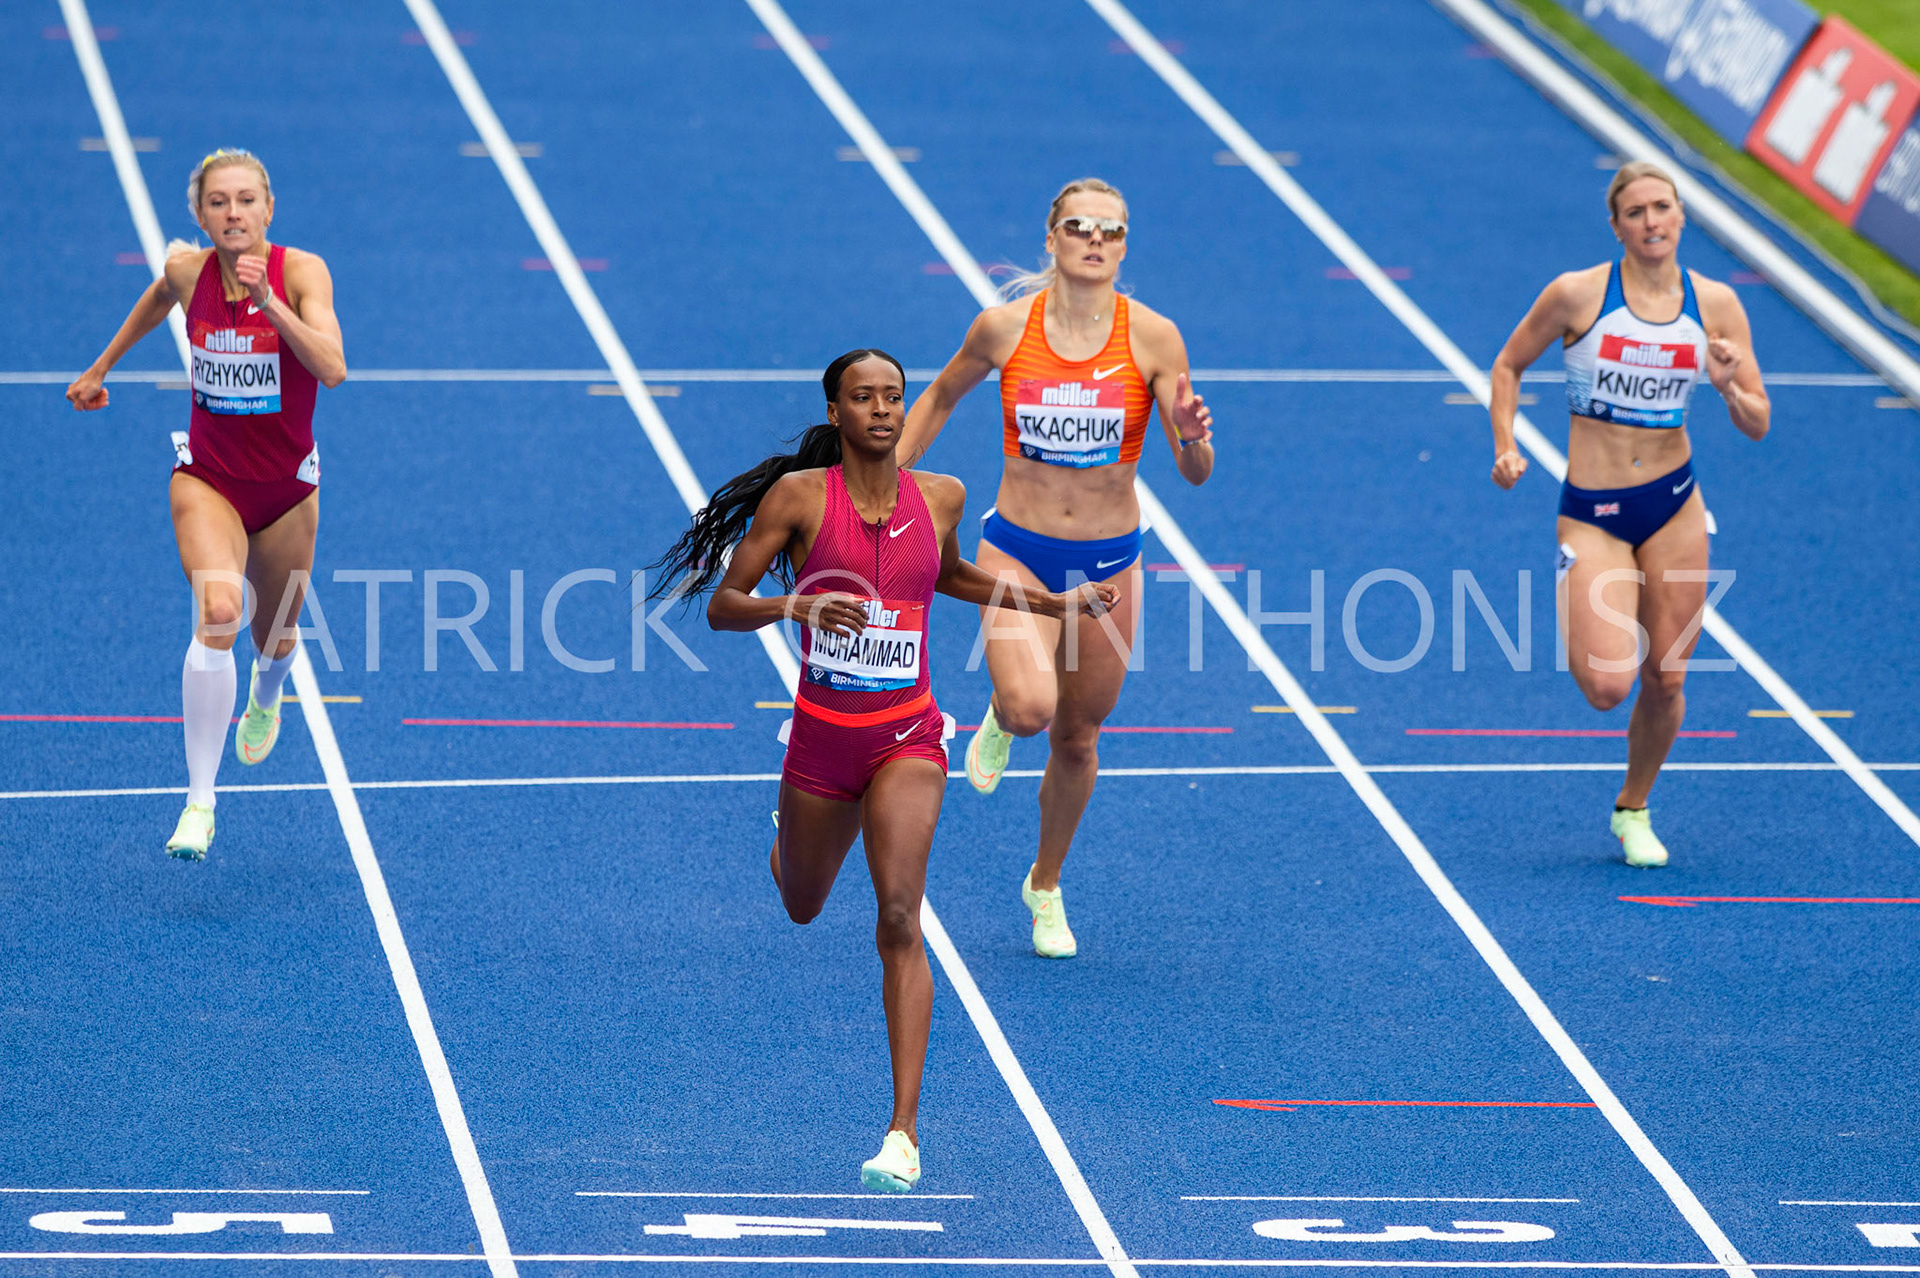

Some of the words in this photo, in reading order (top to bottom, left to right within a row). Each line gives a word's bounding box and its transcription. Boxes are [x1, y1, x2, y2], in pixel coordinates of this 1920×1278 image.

[205, 328, 255, 352] müller
[1621, 344, 1677, 367] müller
[194, 356, 277, 388] RYZHYKOVA
[1041, 382, 1100, 406] müller
[1597, 369, 1688, 400] KNIGHT
[206, 398, 267, 410] BIRMINGHAM
[1019, 415, 1121, 442] TKACHUK
[1041, 451, 1107, 464] BIRMINGHAM
[814, 627, 915, 668] MUHAMMAD
[29, 1211, 334, 1235] 5
[644, 1214, 944, 1239] 4
[1252, 1219, 1555, 1242] 3
